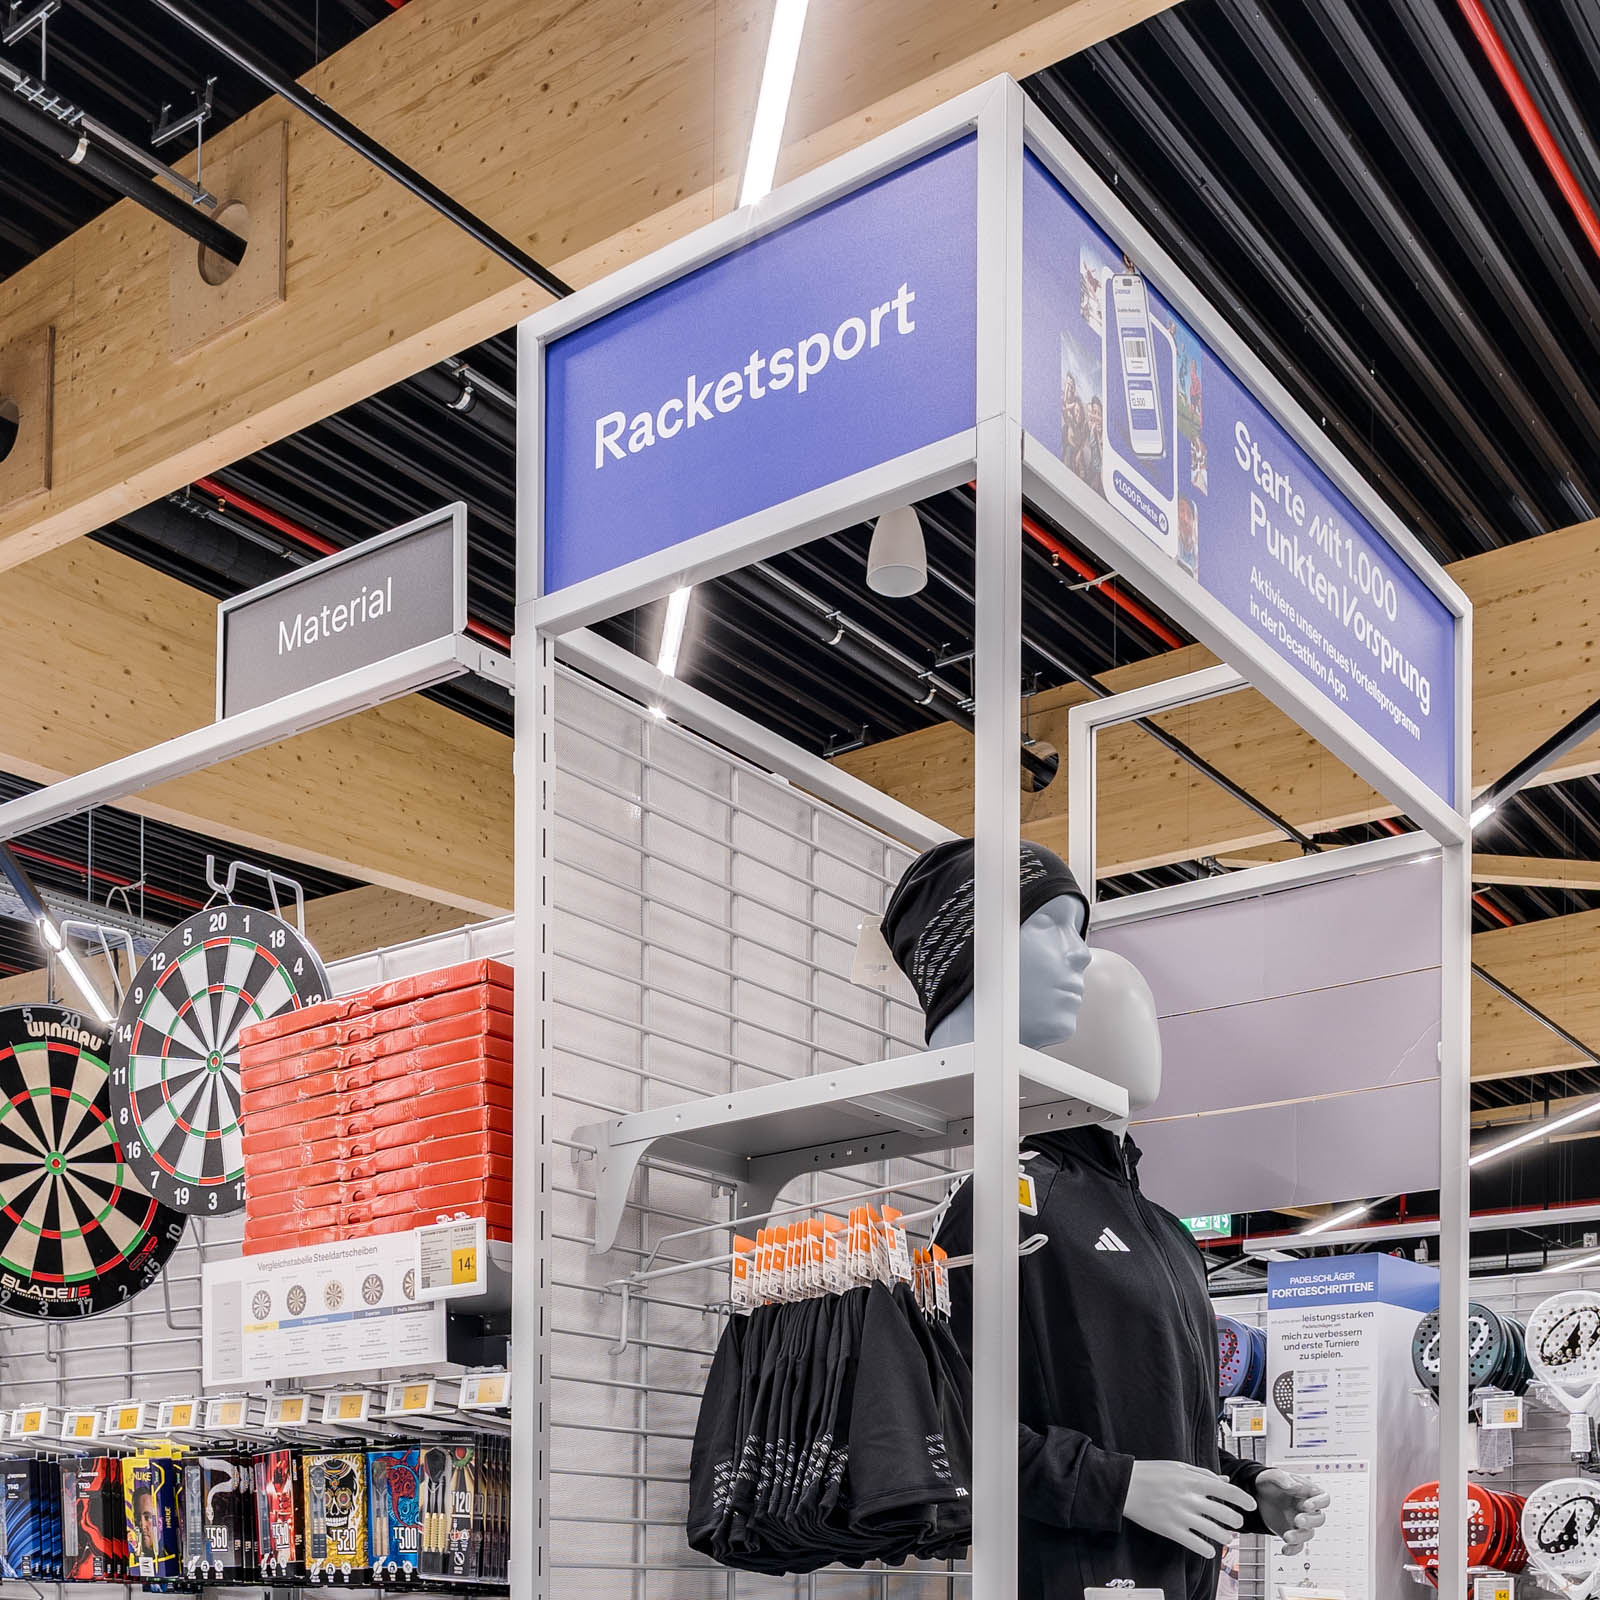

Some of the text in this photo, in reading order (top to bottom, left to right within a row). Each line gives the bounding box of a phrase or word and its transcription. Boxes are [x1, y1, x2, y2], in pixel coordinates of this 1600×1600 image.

[593, 282, 917, 470] Racketsport
[1234, 420, 1305, 526] Starte
[1345, 539, 1397, 623] 1.000
[1250, 491, 1431, 717] Punkten Vorsprung
[278, 576, 393, 655] Material
[1250, 598, 1349, 702] in der Decathlon App.
[1250, 566, 1420, 741] Aktiviere unser neues Vorteilsprogramm
[209, 912, 228, 932] 20
[243, 914, 251, 933] 1
[183, 927, 192, 946] 5
[269, 929, 286, 948] 18
[150, 952, 166, 971] 12
[293, 957, 304, 976] 4
[134, 987, 144, 1005] 9
[22, 1008, 34, 1024] 5
[61, 1012, 81, 1030] 20
[117, 1025, 132, 1042] 14
[113, 1067, 127, 1085] 11
[119, 1107, 129, 1124] 8
[126, 1141, 142, 1159] 16
[151, 1171, 160, 1189] 7
[174, 1187, 189, 1205] 19
[208, 1193, 218, 1210] 3
[257, 1244, 378, 1272] Vergleichstabelle Steeldartscheiben
[143, 1261, 162, 1279] 15
[1289, 1272, 1355, 1285] PADELSCHLÄGER
[118, 1285, 131, 1300] 2
[1272, 1282, 1374, 1298] FORTGESCHRITTENE
[38, 1300, 49, 1316] 3
[77, 1299, 93, 1315] 17
[1302, 1310, 1374, 1322] leistungsstarken
[1281, 1332, 1302, 1340] mich
[1314, 1329, 1362, 1338] verbessern
[1284, 1340, 1360, 1351] und erste Turniere
[1310, 1350, 1343, 1361] spielen.
